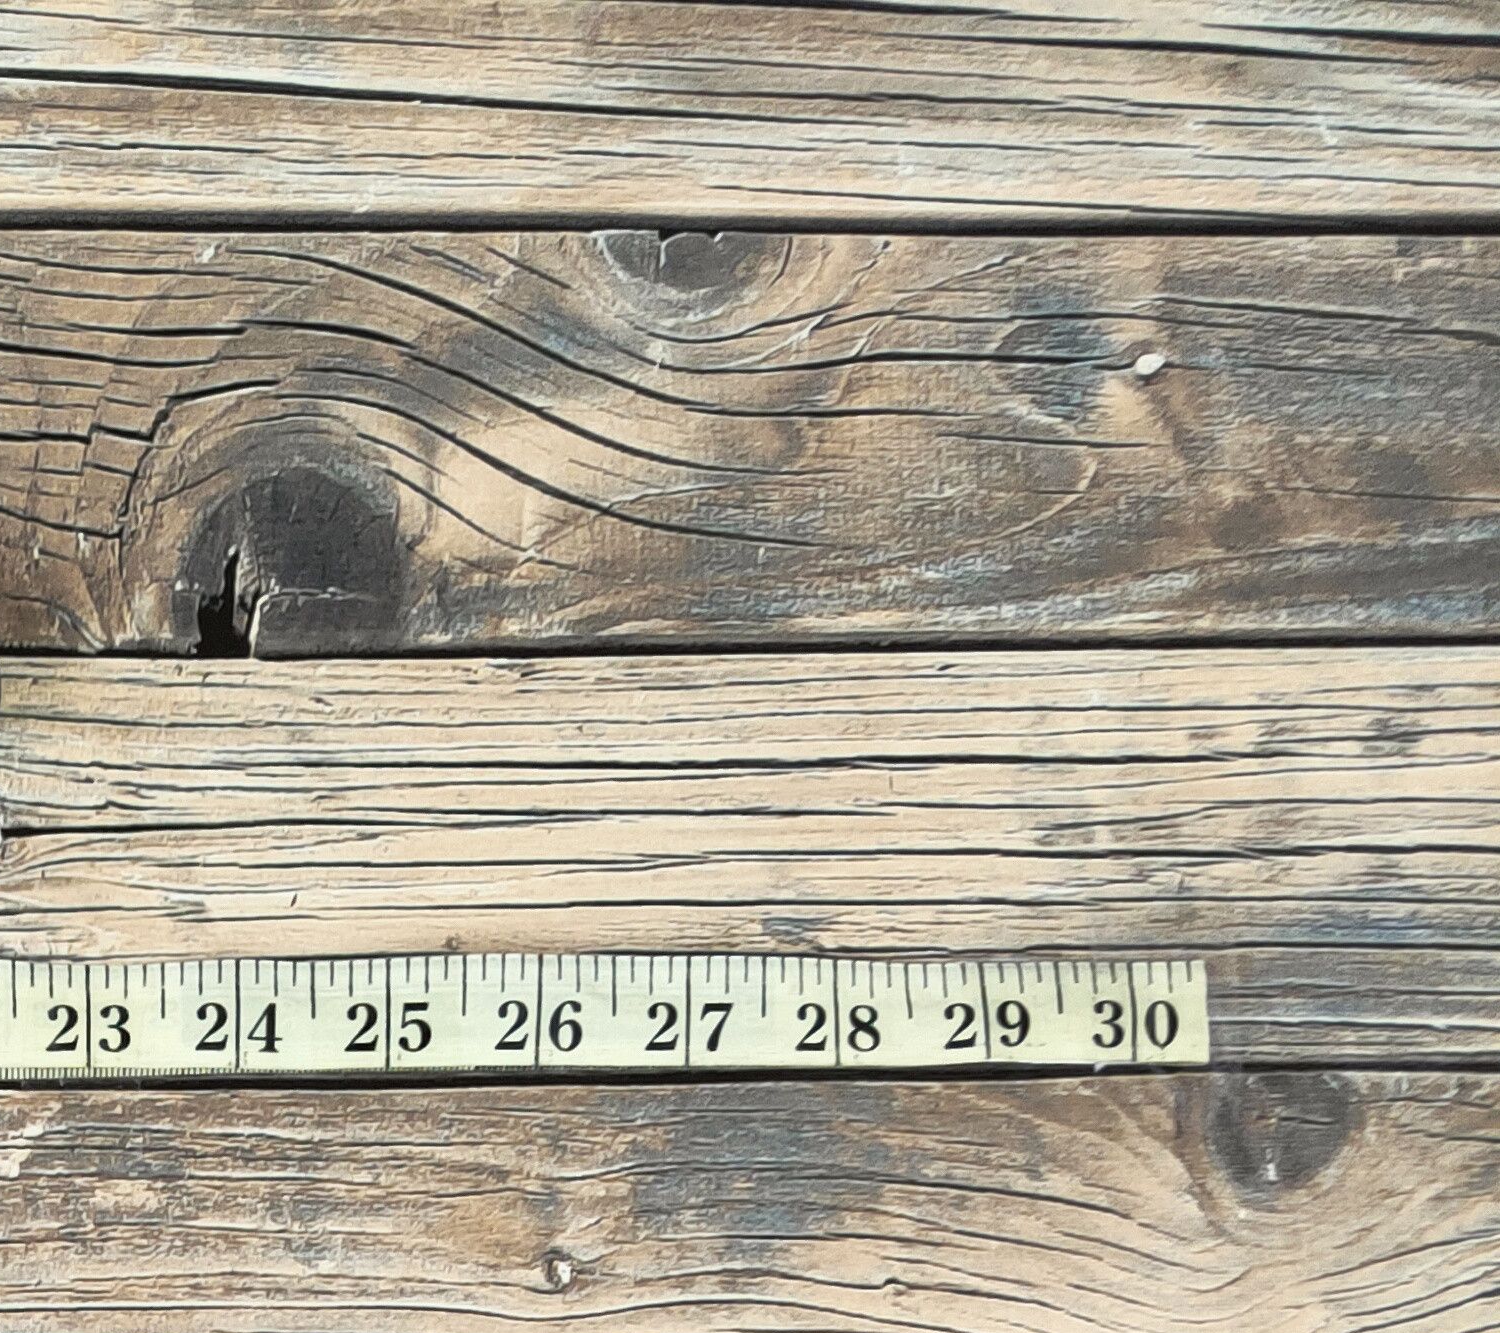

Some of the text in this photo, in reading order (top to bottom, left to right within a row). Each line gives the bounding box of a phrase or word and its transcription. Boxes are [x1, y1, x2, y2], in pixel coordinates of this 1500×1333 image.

[45, 1003, 132, 1053] 23
[194, 1002, 284, 1053] 24
[343, 1001, 433, 1053] 25
[494, 999, 584, 1052] 26
[644, 1001, 734, 1053] 27
[795, 1002, 881, 1053] 28
[942, 999, 1032, 1050] 29
[1092, 999, 1180, 1050] 30
